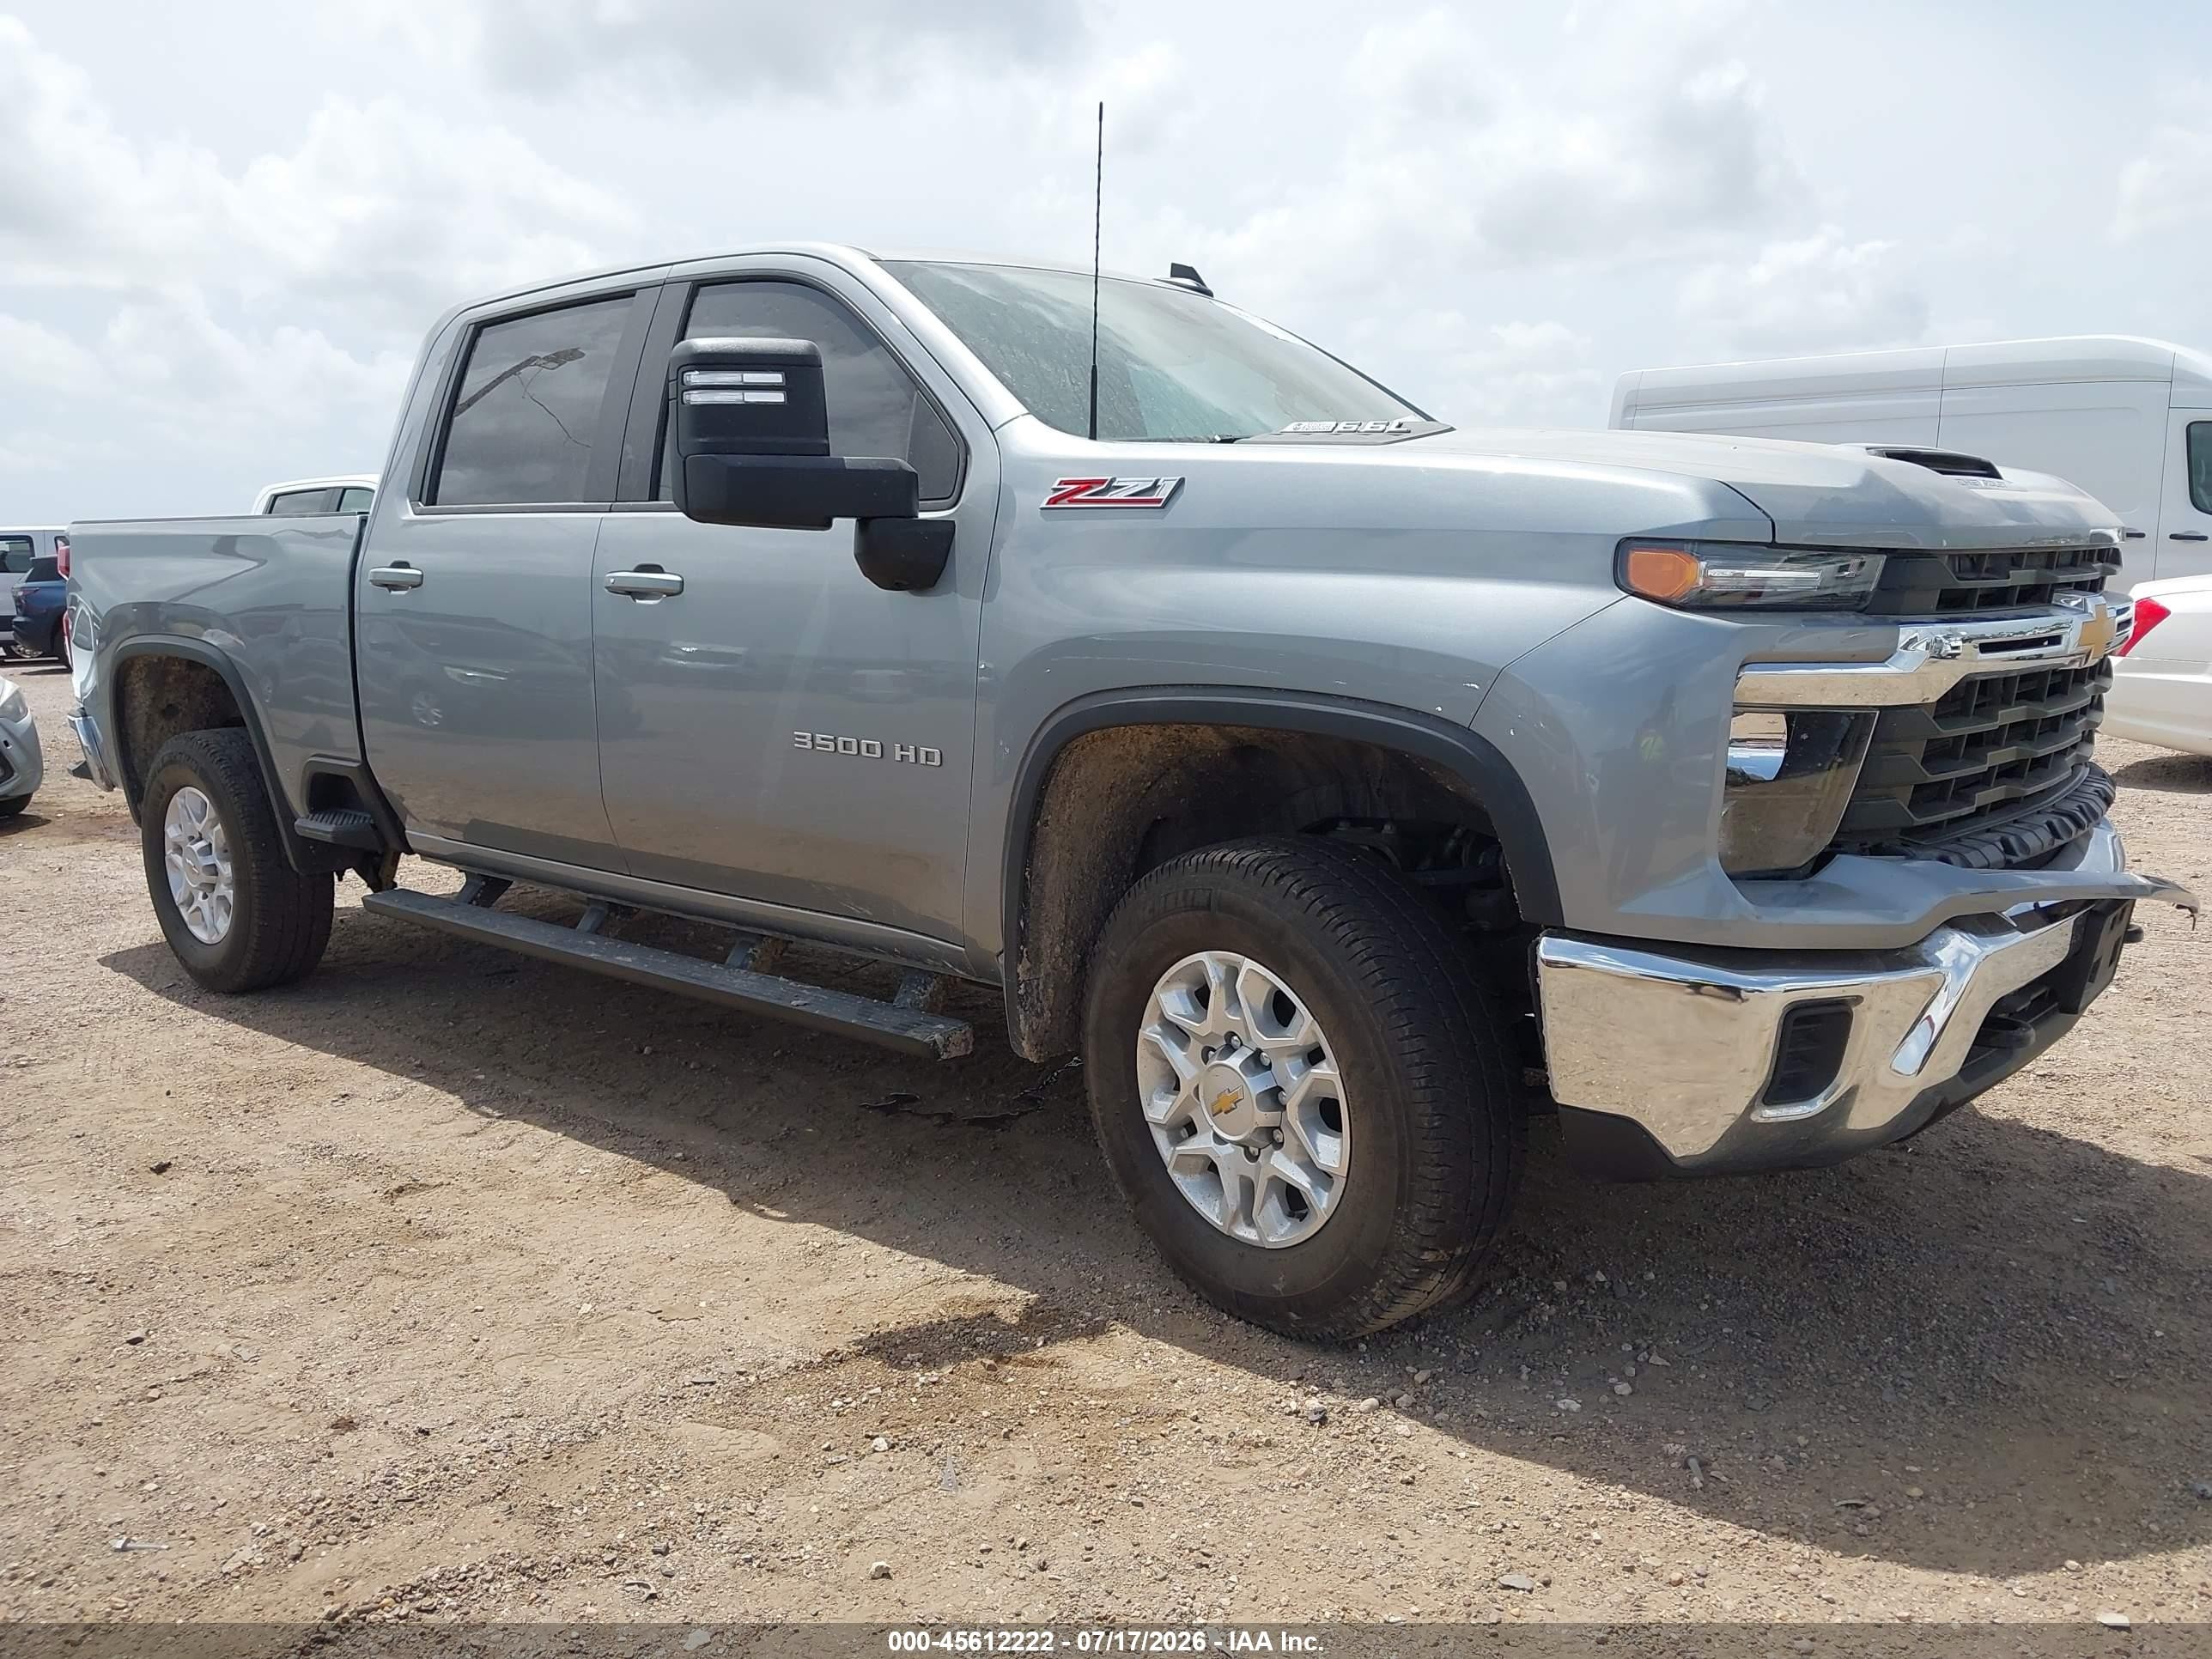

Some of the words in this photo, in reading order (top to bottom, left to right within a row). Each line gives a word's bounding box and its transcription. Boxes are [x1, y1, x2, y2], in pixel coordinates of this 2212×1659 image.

[1039, 477, 1185, 510] Z71
[793, 731, 883, 758] 3500
[894, 744, 943, 767] HD
